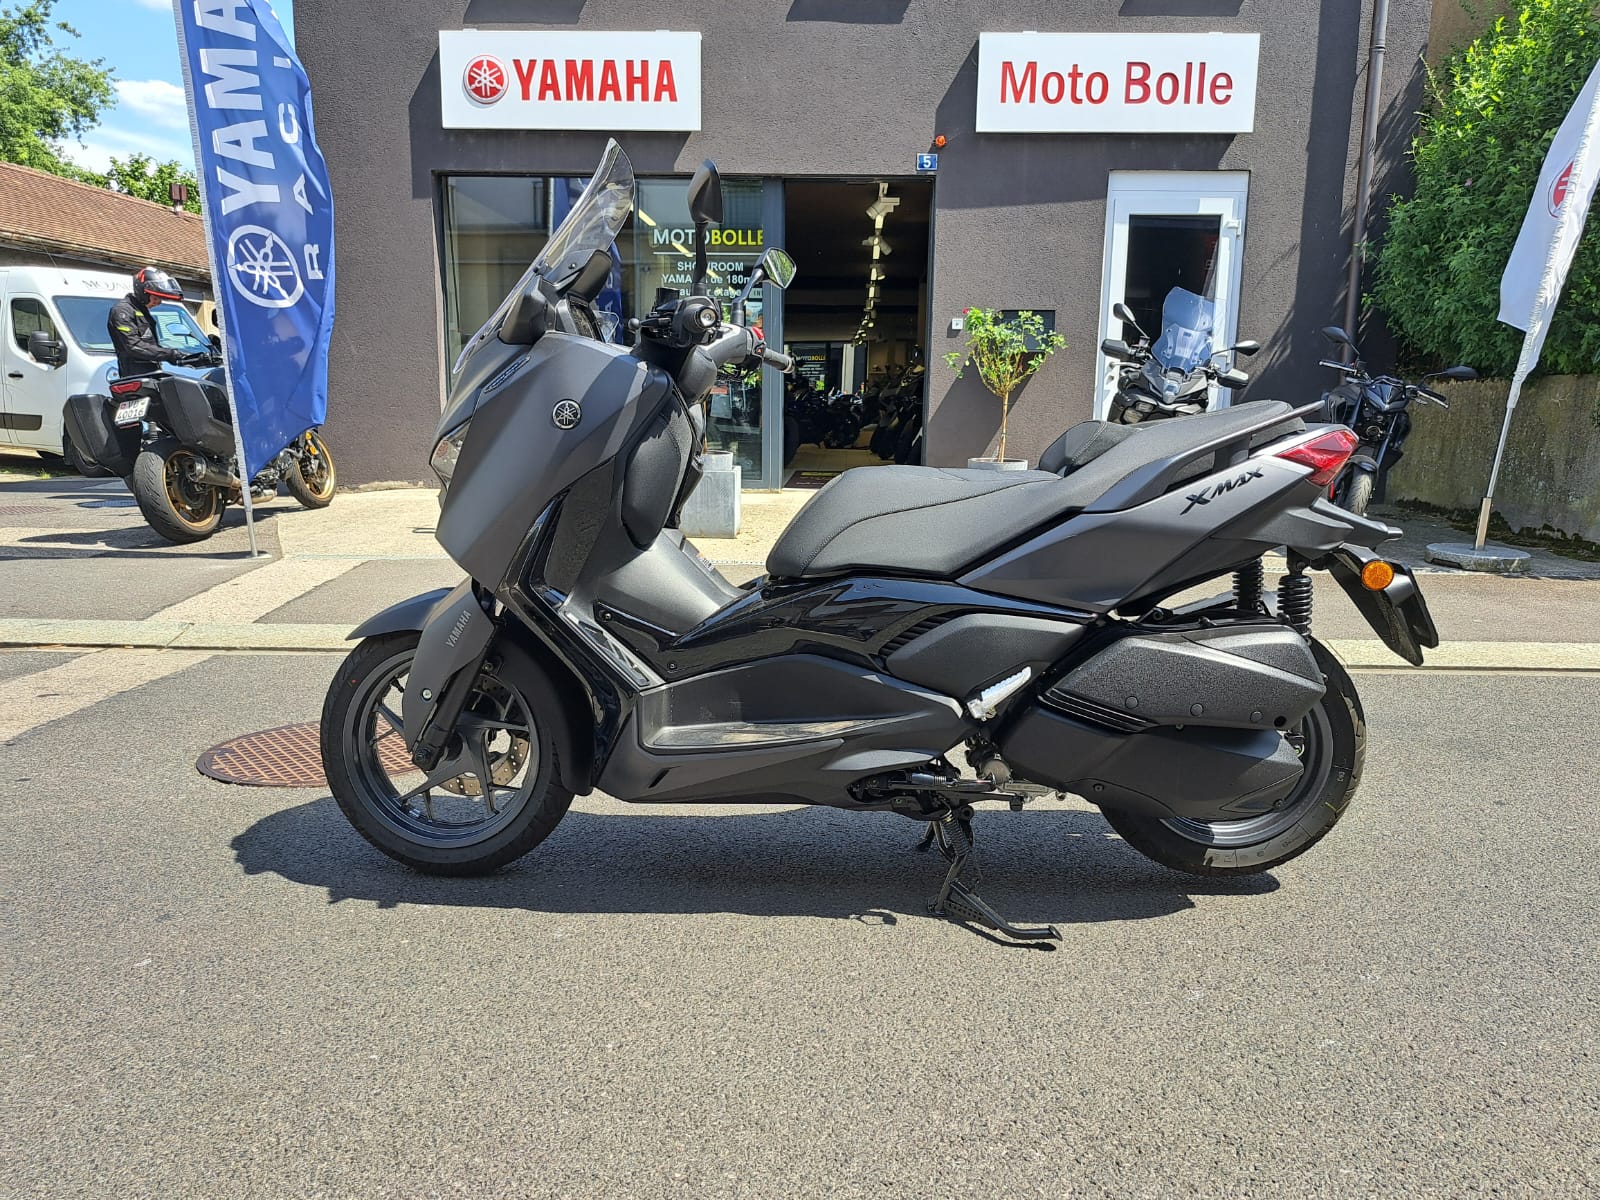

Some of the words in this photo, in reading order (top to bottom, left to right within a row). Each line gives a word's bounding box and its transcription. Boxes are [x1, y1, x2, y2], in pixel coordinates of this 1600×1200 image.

[512, 59, 678, 102] YAMAHA
[1000, 61, 1109, 104] Moto
[1124, 61, 1233, 105] Bolle
[923, 155, 932, 168] 5
[662, 273, 709, 284] YAMA
[710, 274, 723, 284] de
[677, 261, 744, 272] SHROOM
[445, 610, 472, 648] YAMAHA
